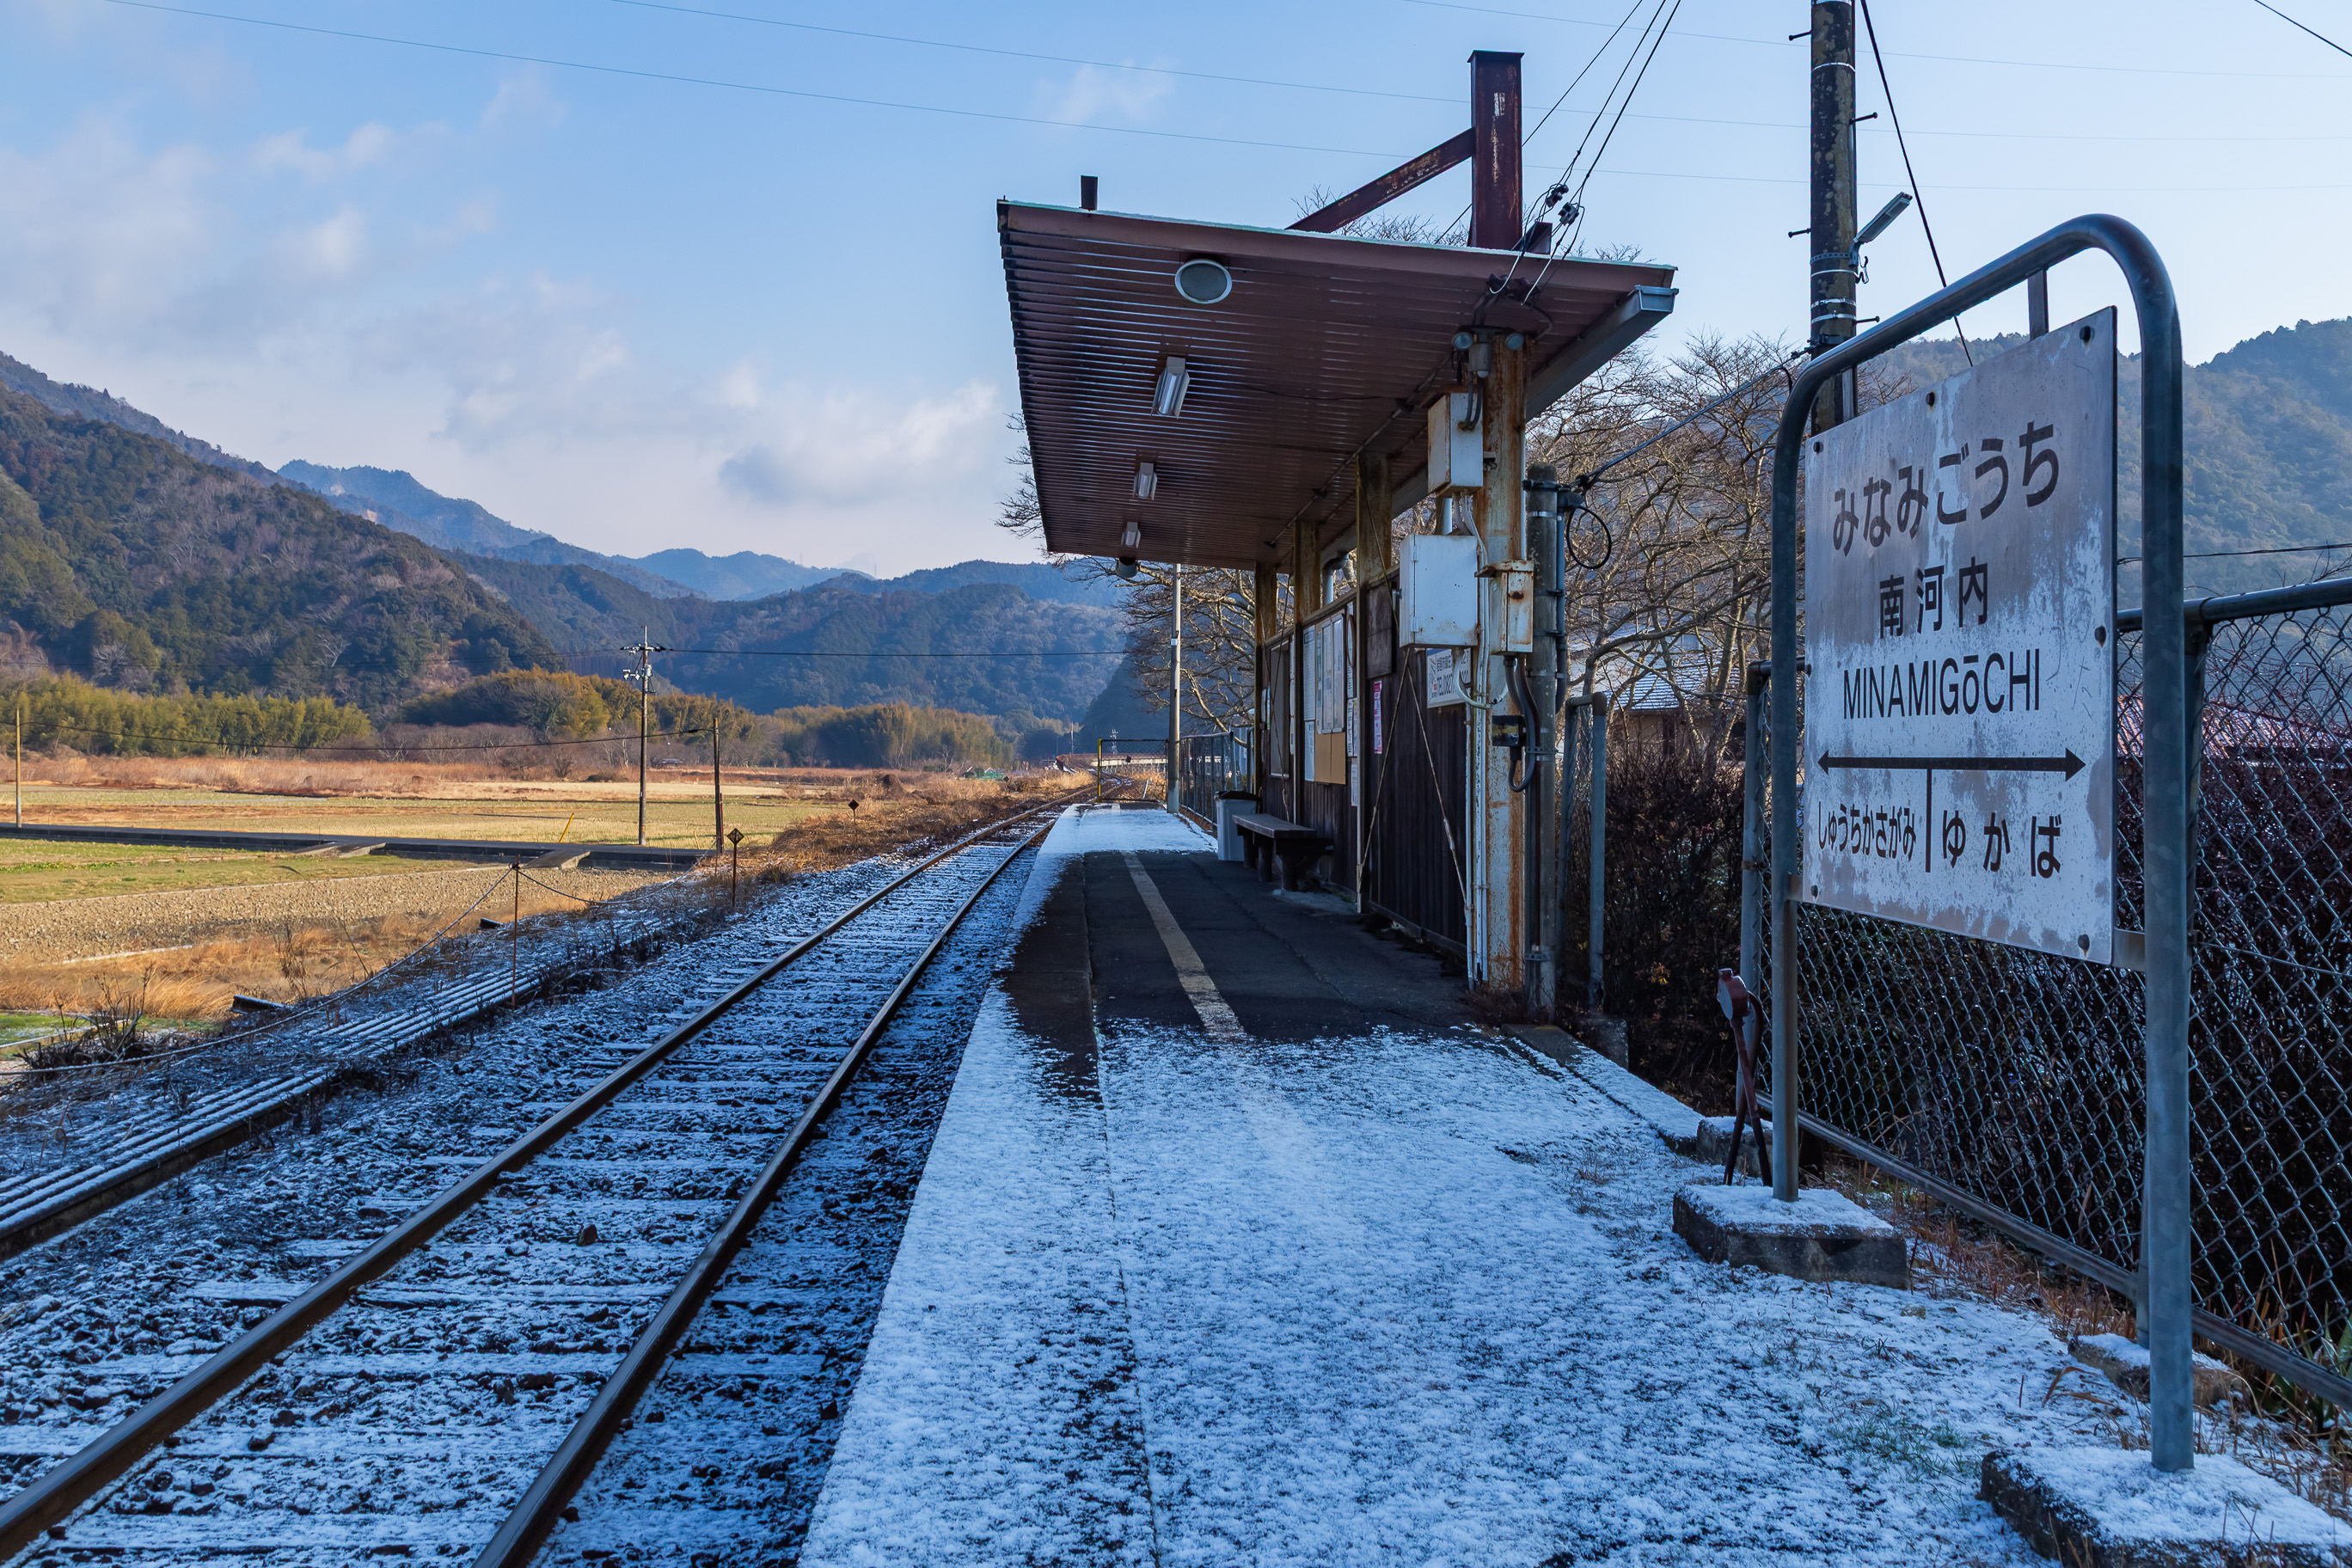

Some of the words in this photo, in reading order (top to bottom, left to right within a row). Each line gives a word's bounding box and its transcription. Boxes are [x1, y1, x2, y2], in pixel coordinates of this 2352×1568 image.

[1833, 420, 2059, 557] みなみごうち
[1879, 556, 1988, 639] 南河内
[1818, 801, 1916, 861] しゅうちかさがみ
